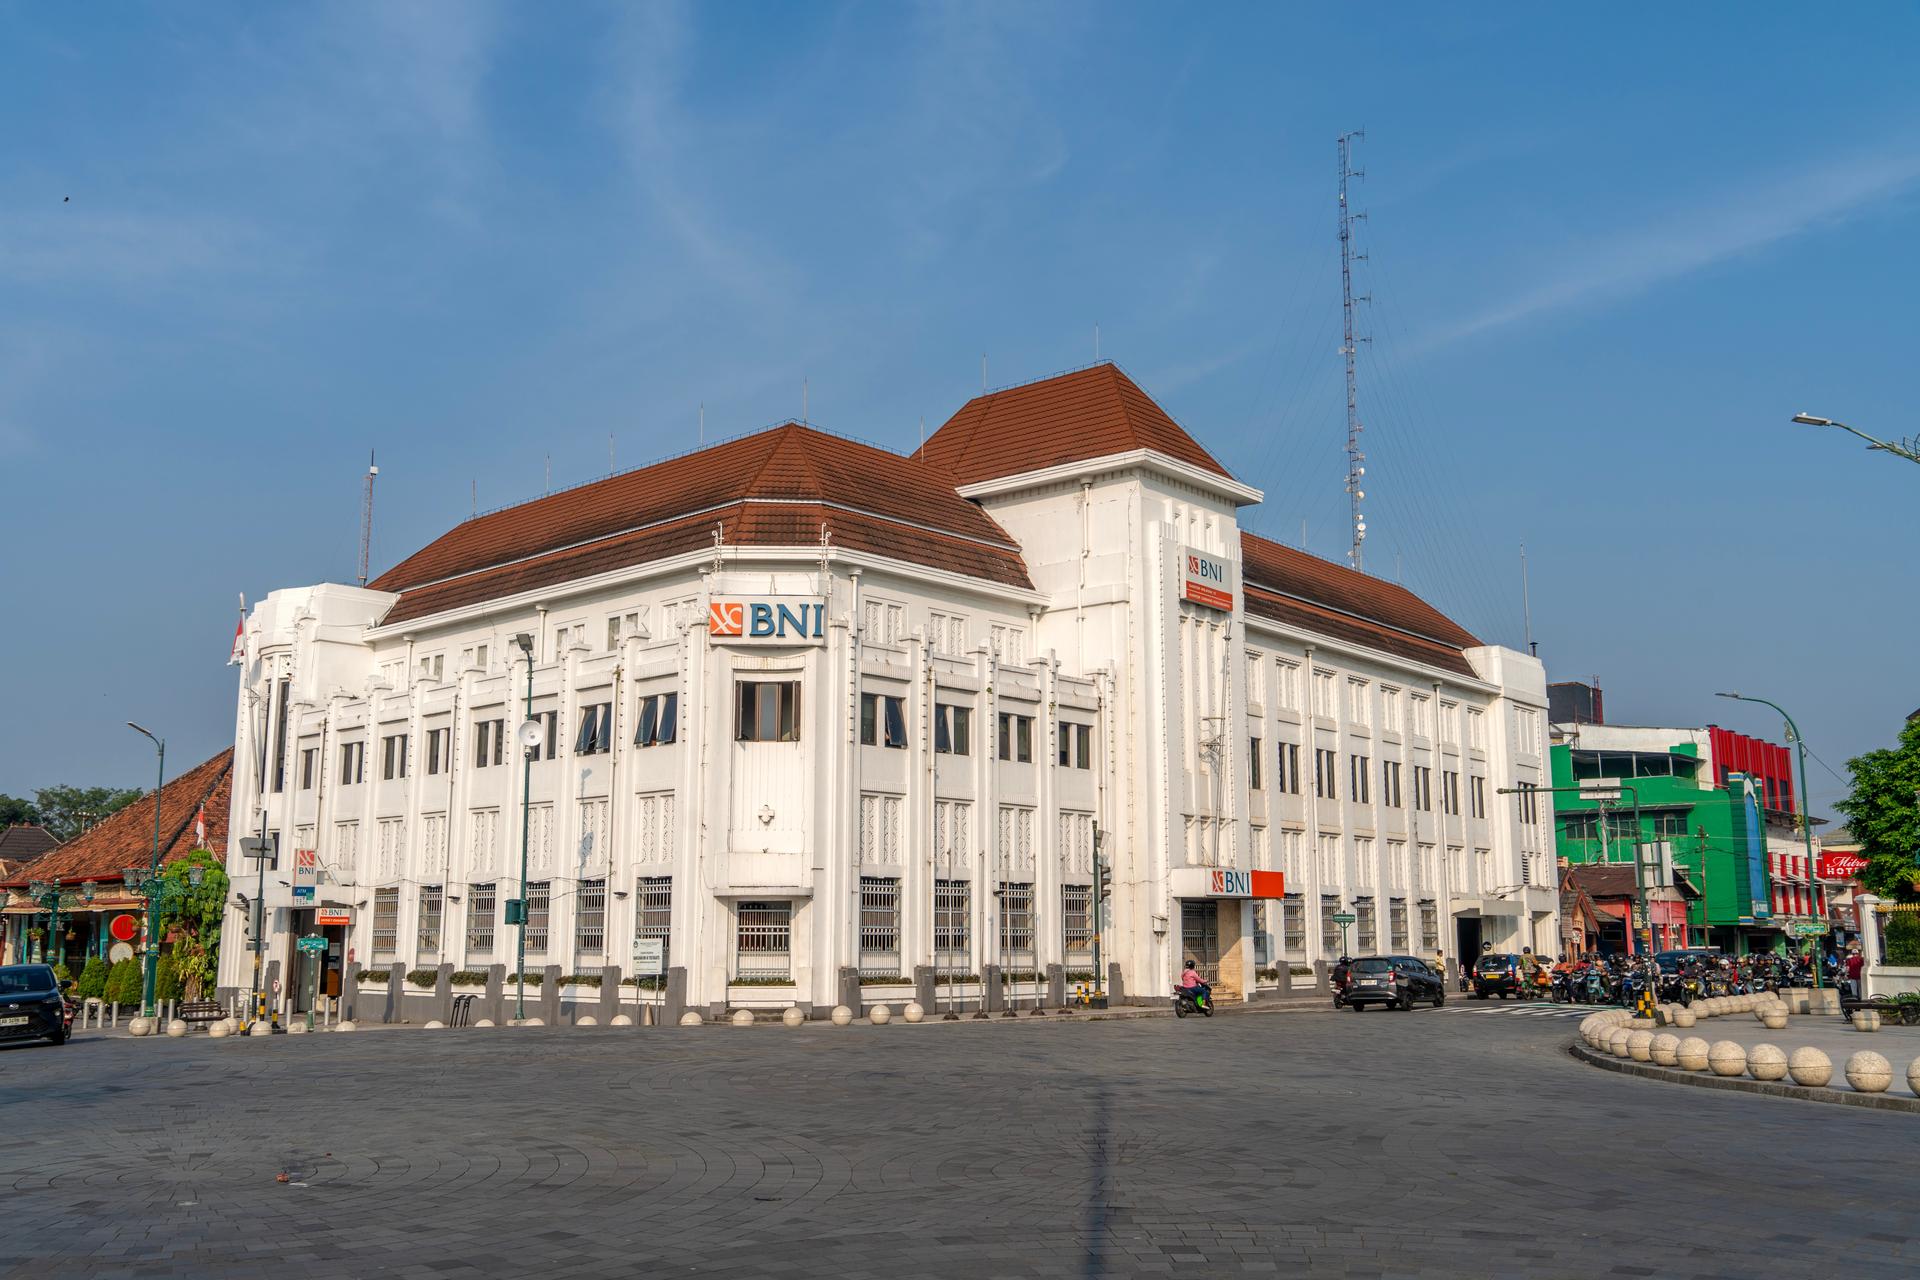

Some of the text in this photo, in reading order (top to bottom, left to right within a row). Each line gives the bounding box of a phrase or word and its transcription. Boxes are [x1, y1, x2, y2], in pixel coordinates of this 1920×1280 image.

[1200, 559, 1223, 583] BNI
[749, 603, 824, 639] BNI
[298, 866, 314, 875] BNI
[1827, 855, 1868, 868] Mitra
[1225, 871, 1250, 894] BNI
[328, 908, 342, 916] BNI
